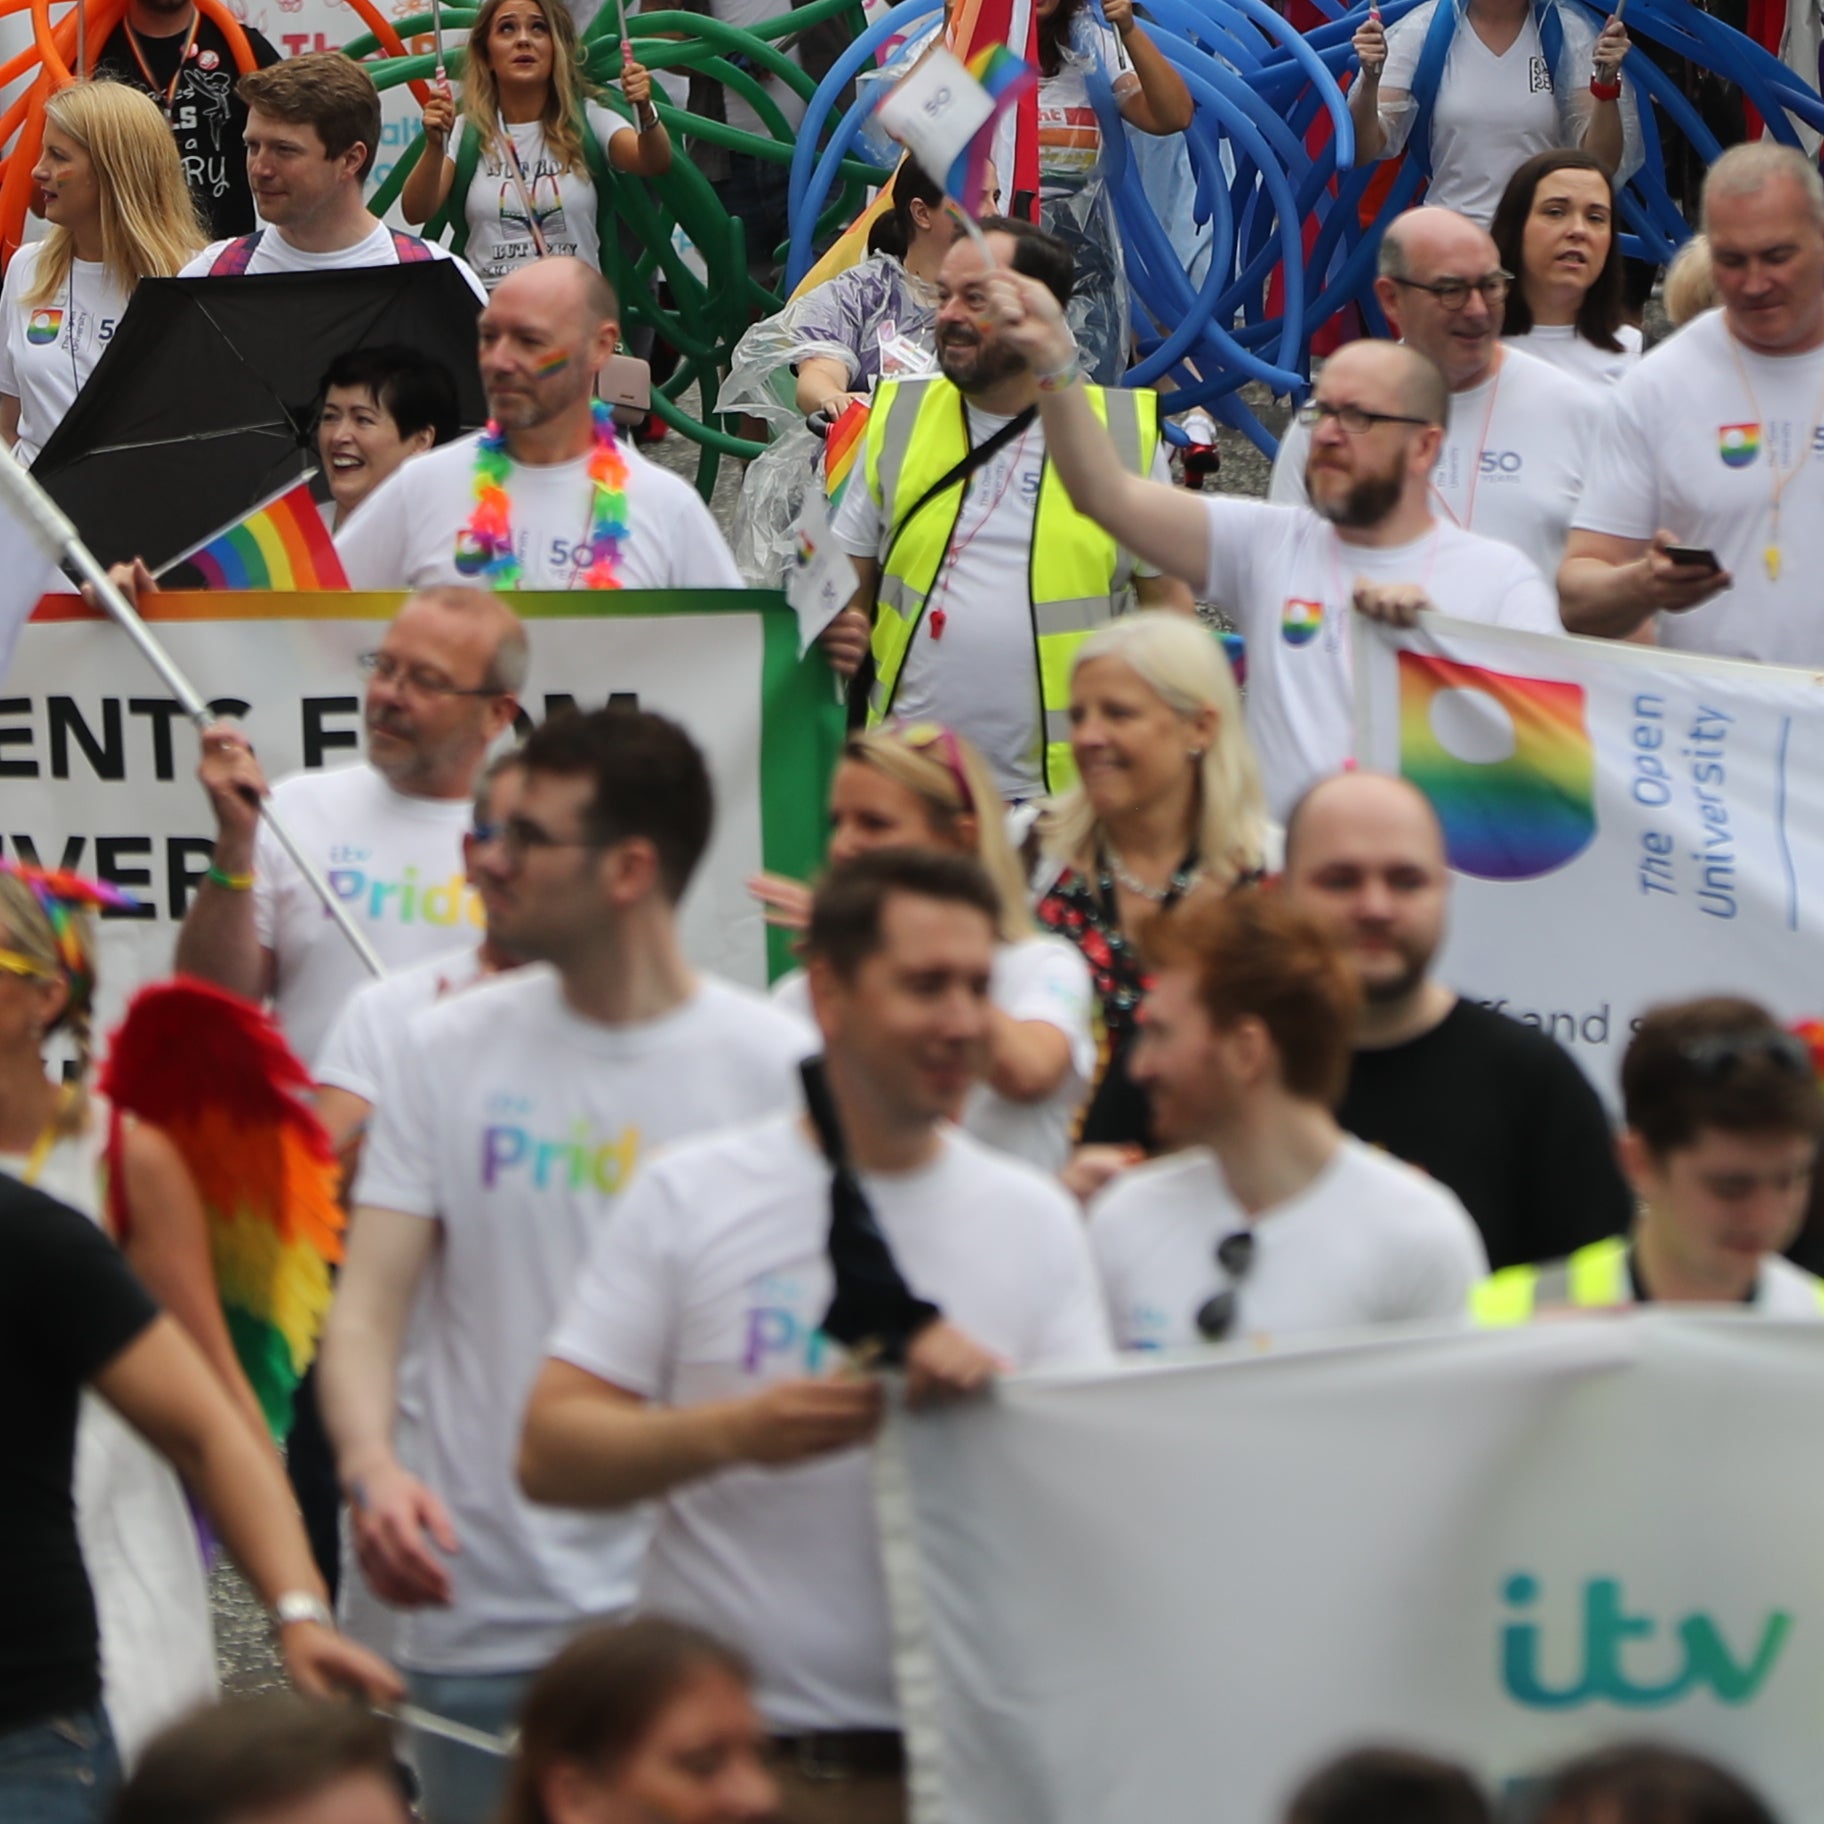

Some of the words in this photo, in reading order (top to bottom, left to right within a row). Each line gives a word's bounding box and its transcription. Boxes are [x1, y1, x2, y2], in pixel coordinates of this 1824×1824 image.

[98, 319, 115, 340] 5
[1479, 451, 1522, 473] 50
[1633, 692, 1670, 808] Open
[1688, 703, 1738, 921] University
[1641, 833, 1675, 898] The
[1522, 1003, 1611, 1044] and
[482, 1120, 641, 1197] Prid
[1498, 1571, 1793, 1710] itv
